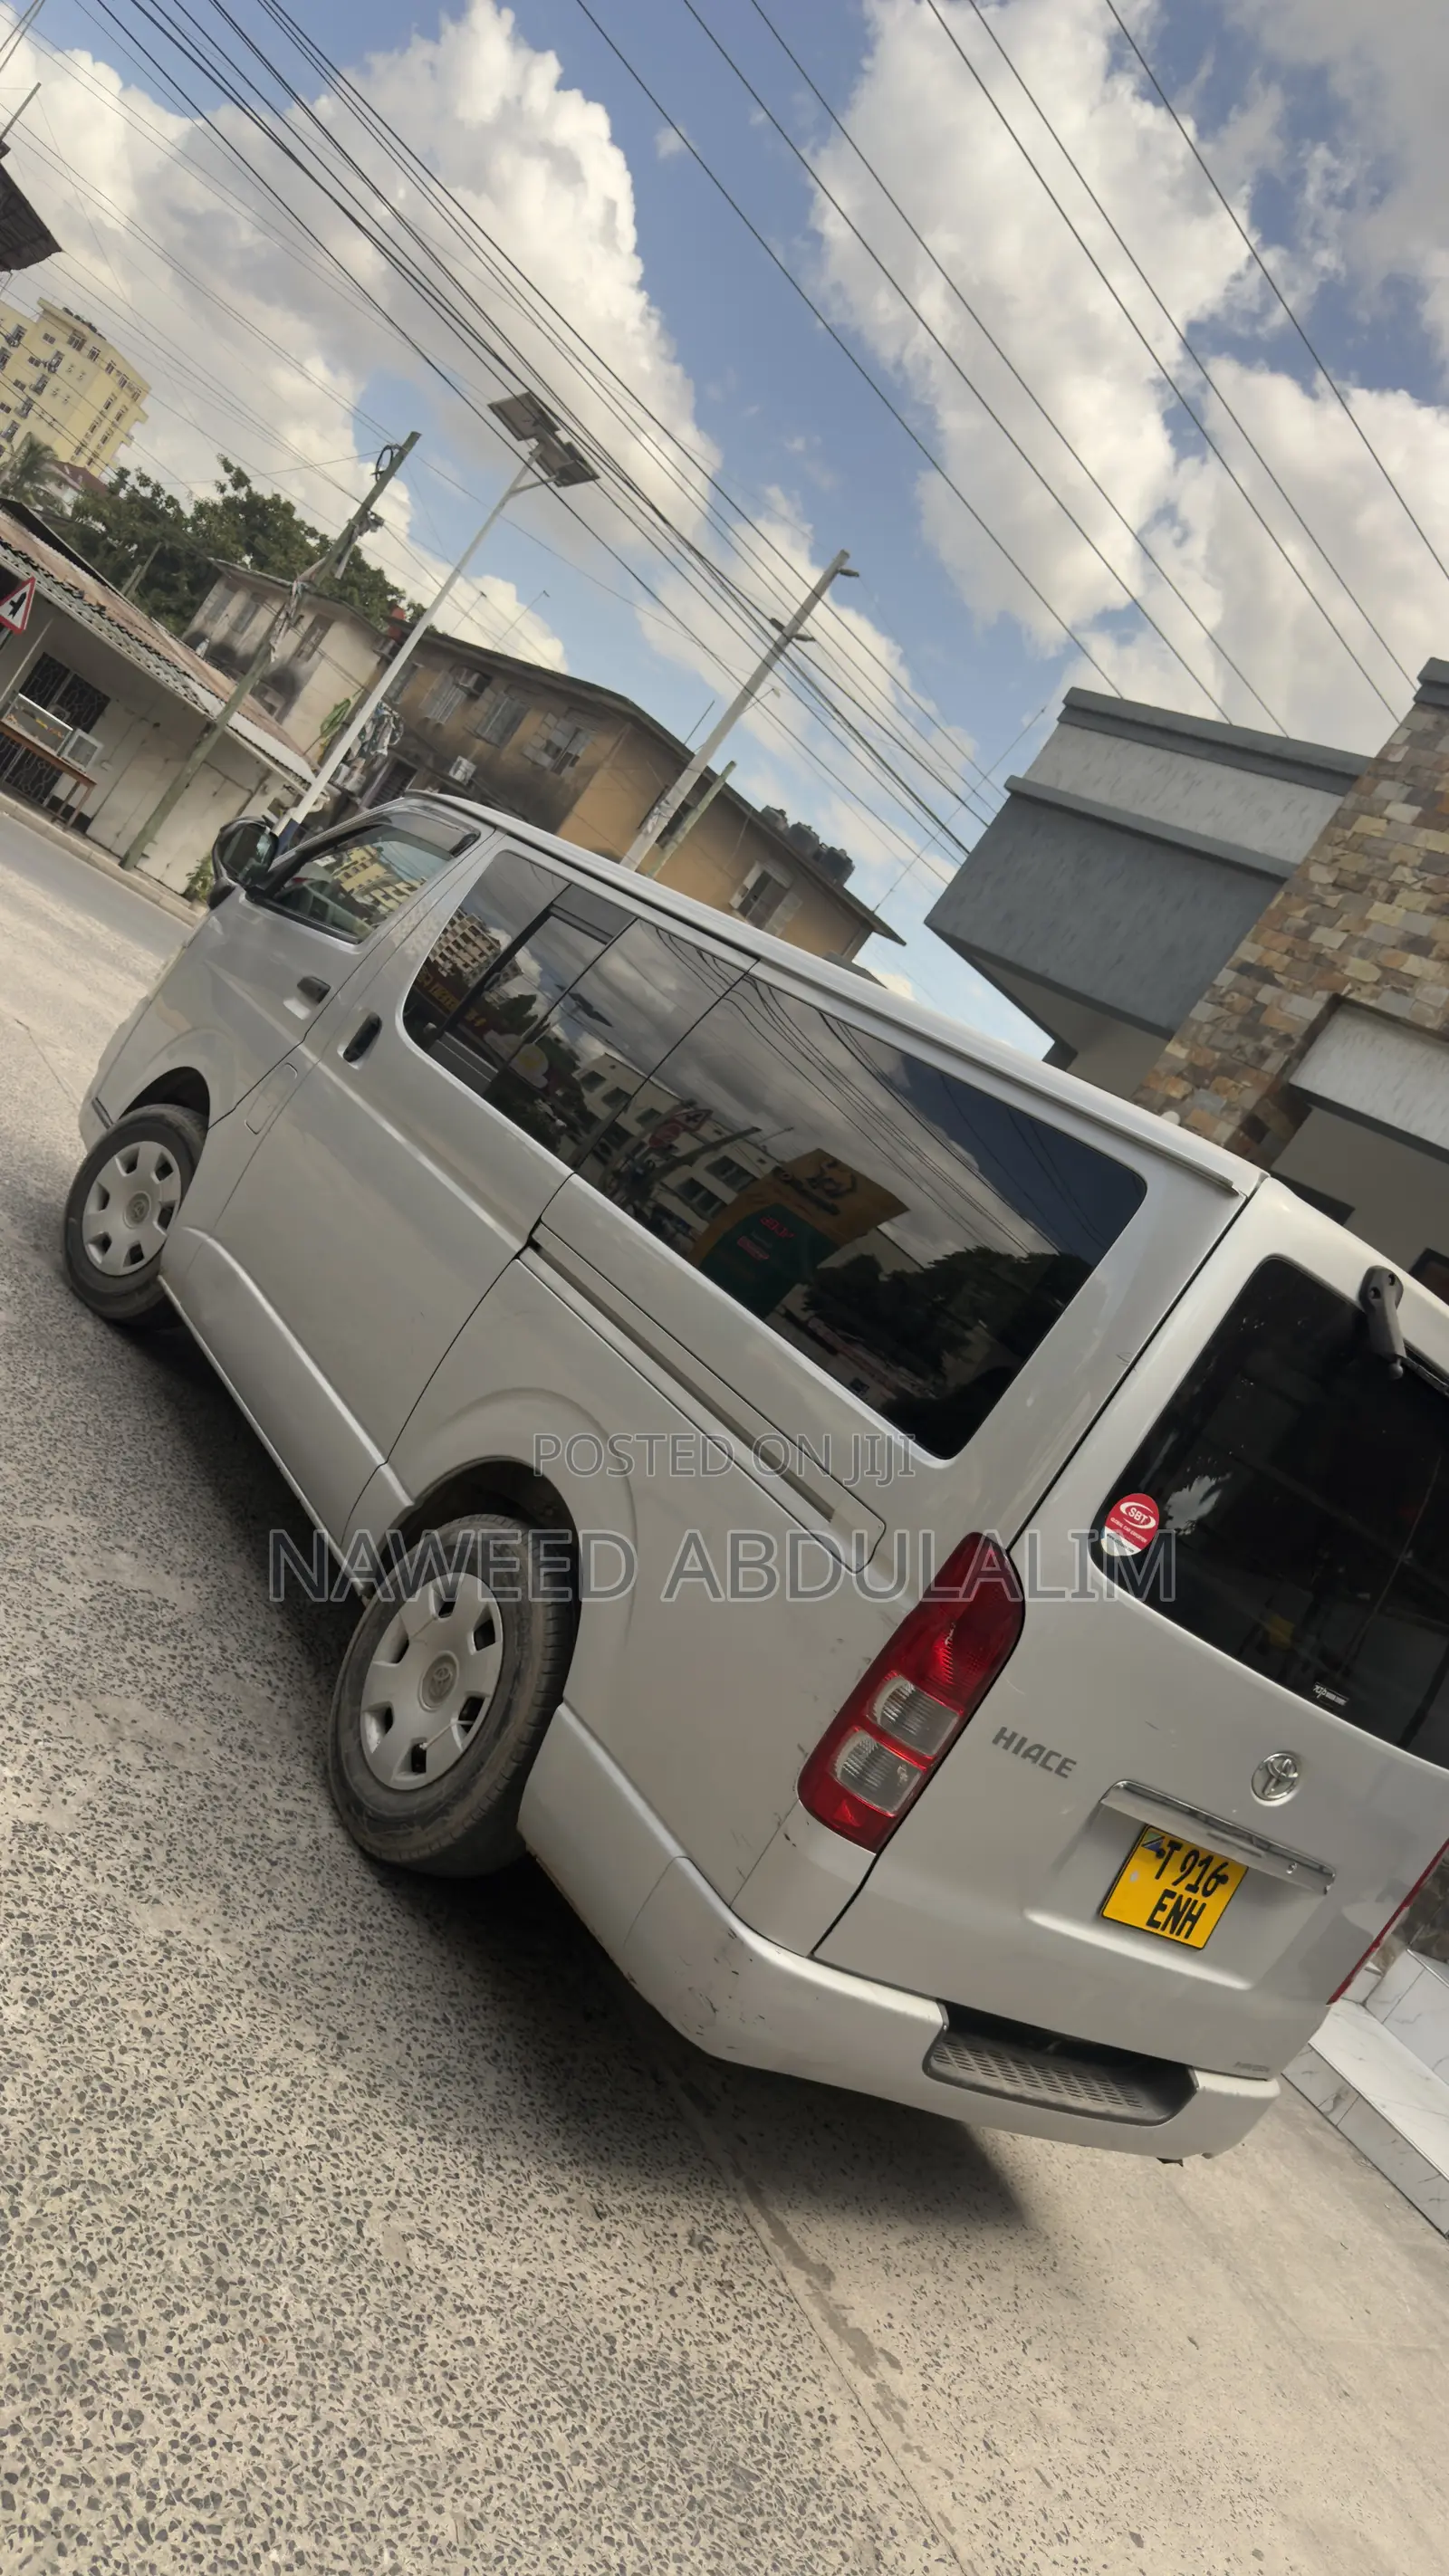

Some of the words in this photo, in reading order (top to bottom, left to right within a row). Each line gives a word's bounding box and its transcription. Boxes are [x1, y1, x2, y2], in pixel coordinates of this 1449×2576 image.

[1128, 1507, 1148, 1524] SBT
[992, 1726, 1077, 1778] HIACE
[1155, 1840, 1183, 1880] T
[1172, 1849, 1229, 1898] 916
[1146, 1888, 1207, 1939] ENH
